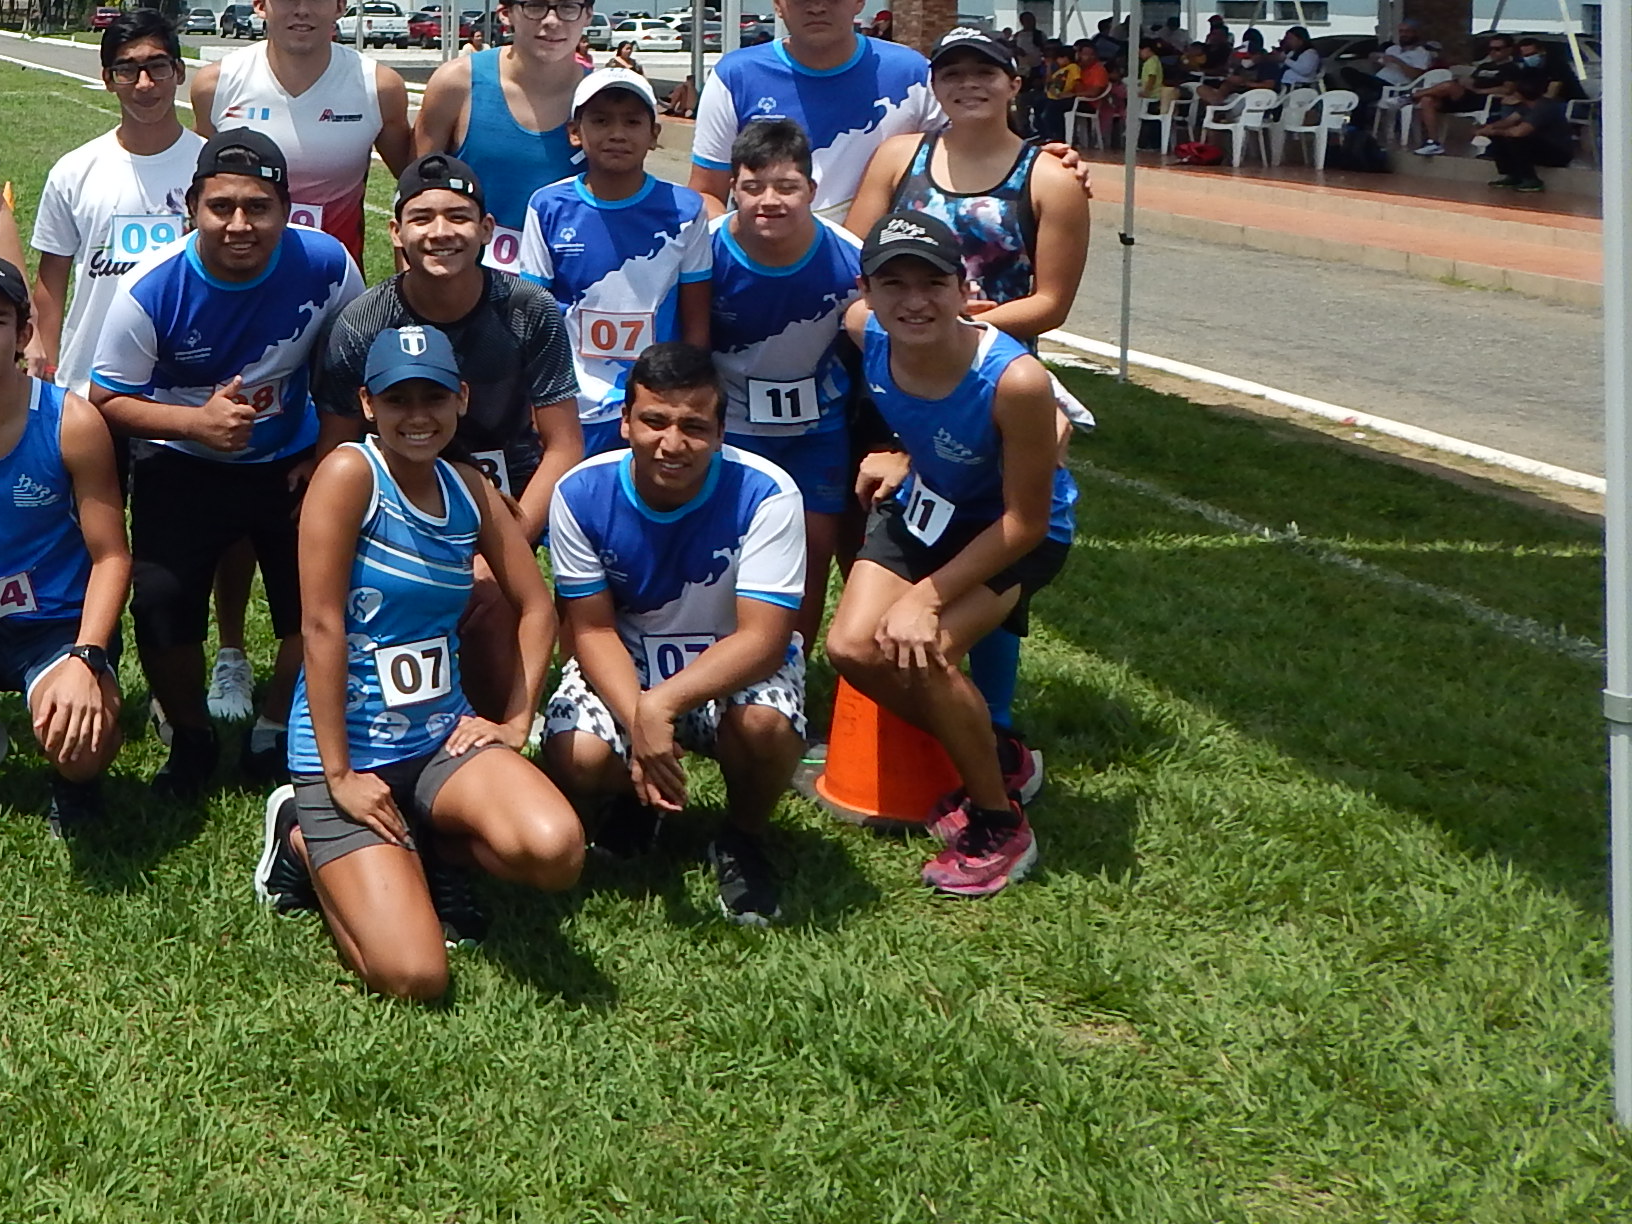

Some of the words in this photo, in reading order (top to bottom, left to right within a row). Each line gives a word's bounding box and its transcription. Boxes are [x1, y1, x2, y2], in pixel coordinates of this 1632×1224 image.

[121, 223, 175, 254] 09
[590, 318, 645, 351] 07
[766, 387, 802, 418] 11
[390, 646, 443, 695] 07
